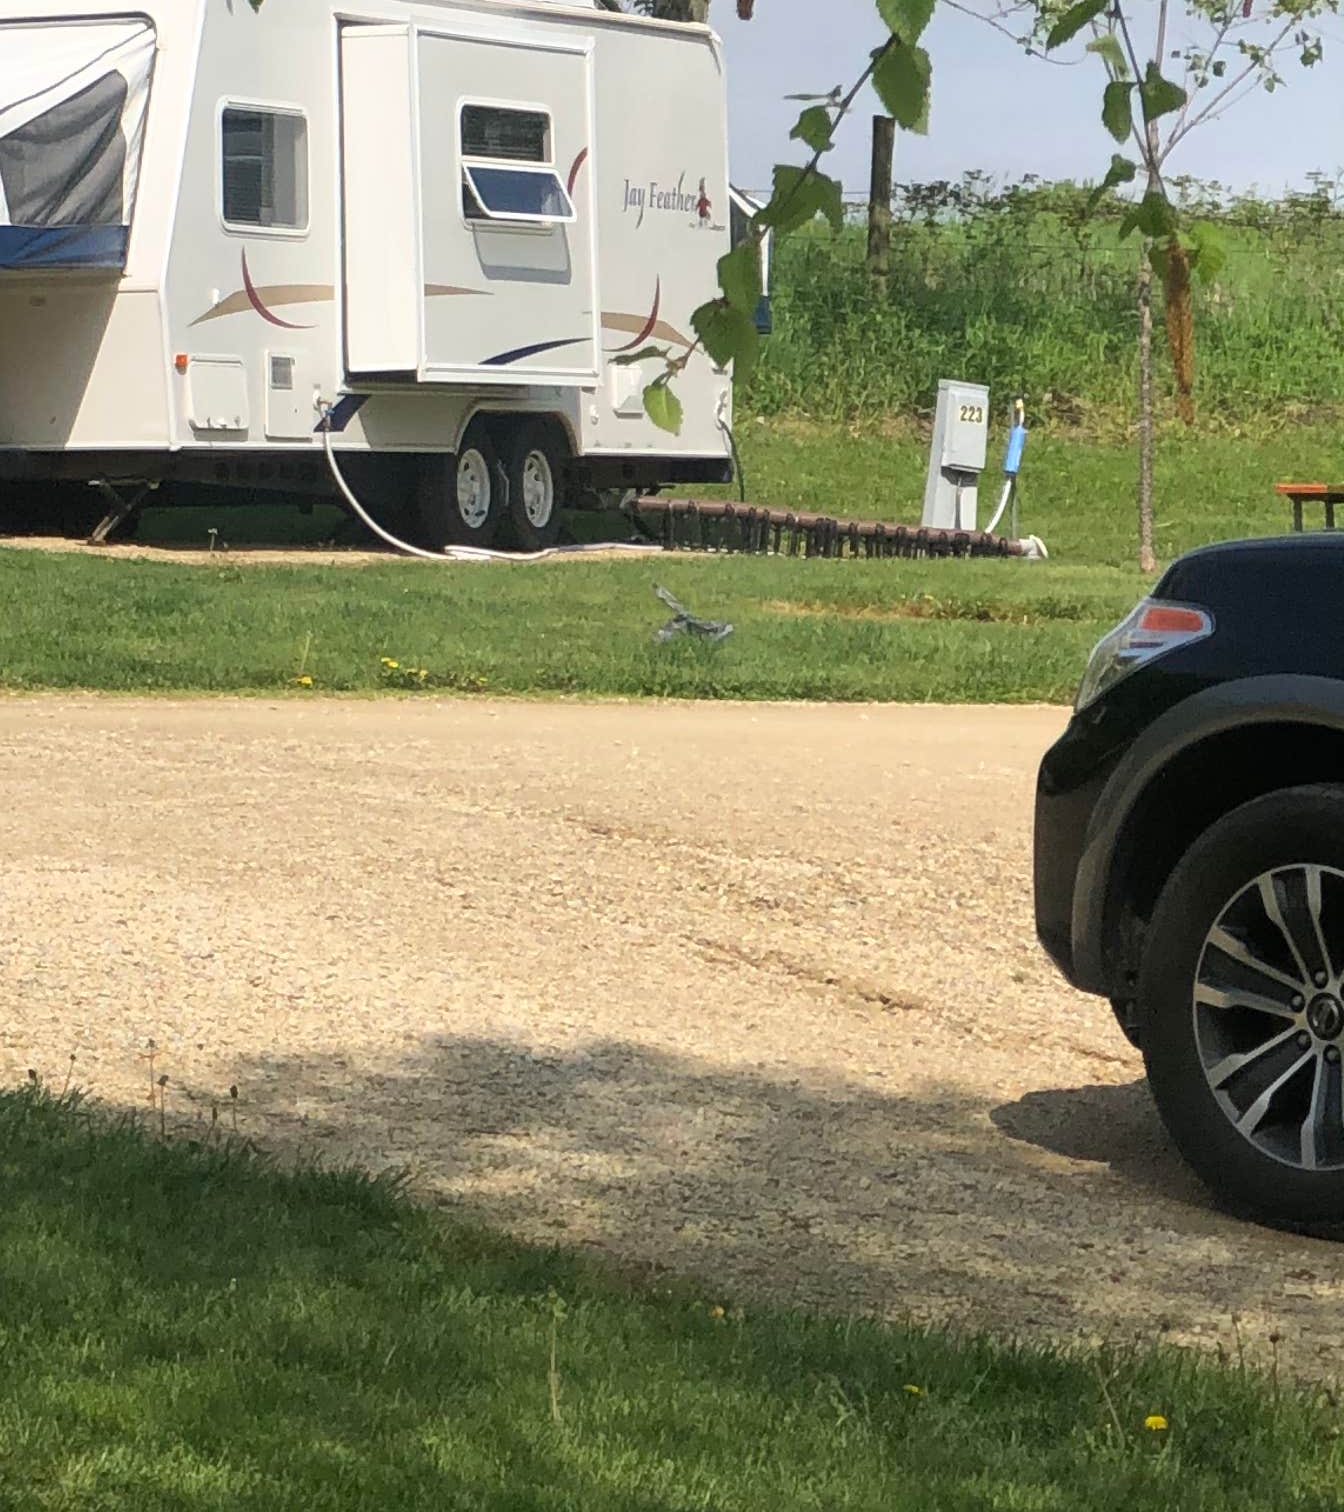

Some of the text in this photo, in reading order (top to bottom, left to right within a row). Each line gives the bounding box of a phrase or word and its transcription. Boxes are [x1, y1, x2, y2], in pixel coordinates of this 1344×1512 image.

[622, 169, 697, 229] Jay Feather
[960, 405, 983, 423] 223
